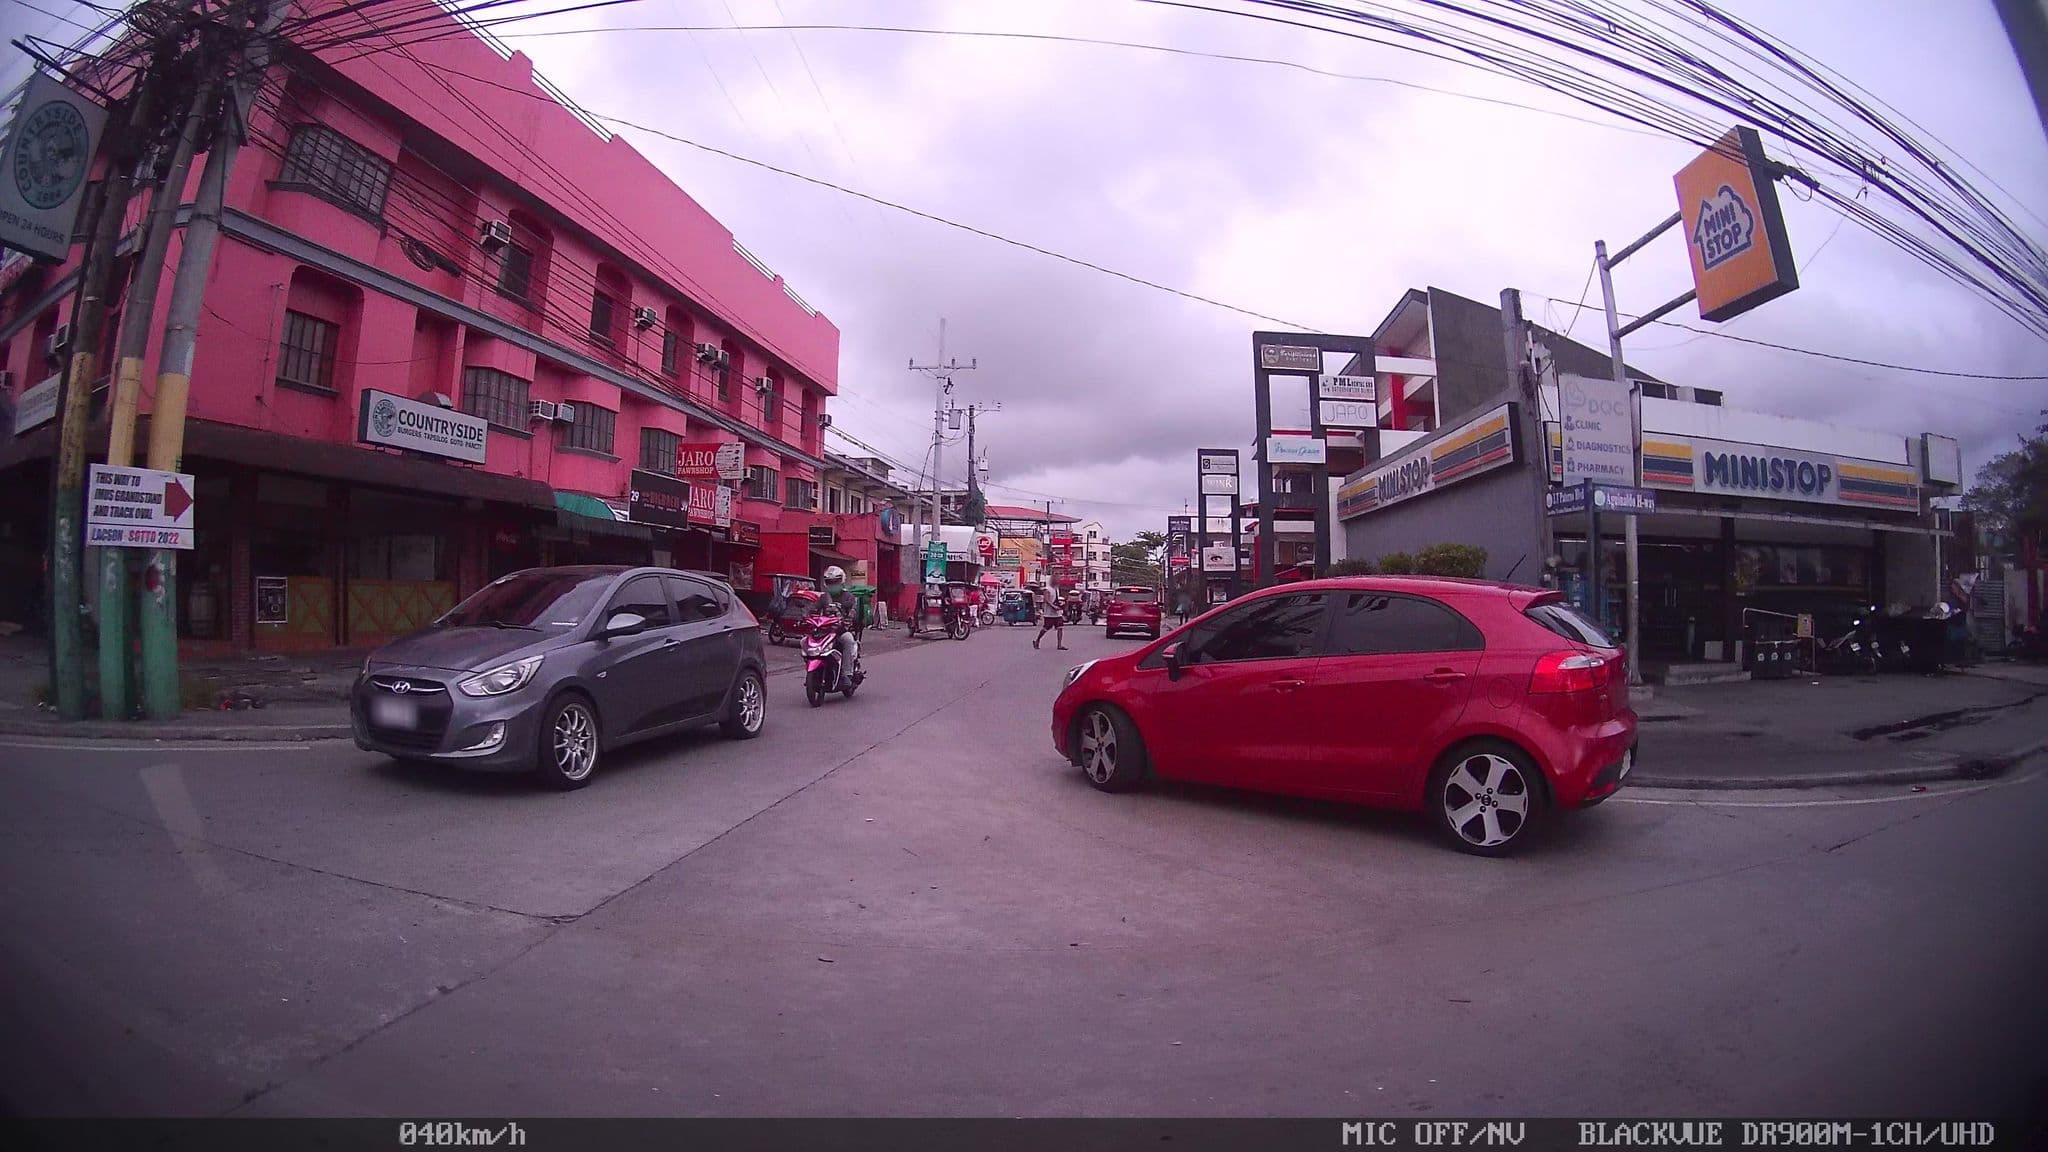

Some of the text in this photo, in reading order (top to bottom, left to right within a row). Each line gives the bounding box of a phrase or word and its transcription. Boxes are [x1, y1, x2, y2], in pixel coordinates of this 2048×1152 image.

[0, 209, 66, 244] PEN 24 HOURS
[1704, 202, 1737, 238] MINI
[1706, 222, 1742, 259] STOP
[1333, 377, 1351, 387] PML
[1325, 405, 1368, 422] JARO
[1588, 400, 1624, 416] DOC
[398, 409, 483, 442] COUNTRYSIDE
[1575, 420, 1601, 431] CLINIC
[1576, 440, 1631, 454] DIAGNOSTICS
[678, 450, 715, 466] JARO
[677, 466, 714, 475] PAWNSHOP
[1577, 462, 1625, 475] PHARMACY
[1704, 451, 1832, 495] MINISTOP
[96, 472, 141, 487] THIS WAY TO
[1378, 456, 1430, 502] MINISTOP
[94, 488, 162, 504] IMUS GRANDSTAND
[1606, 492, 1636, 511] Aguinaldo
[93, 505, 153, 520] AND TRACK OVAL
[91, 528, 179, 545] LACSON SOTTO 2022
